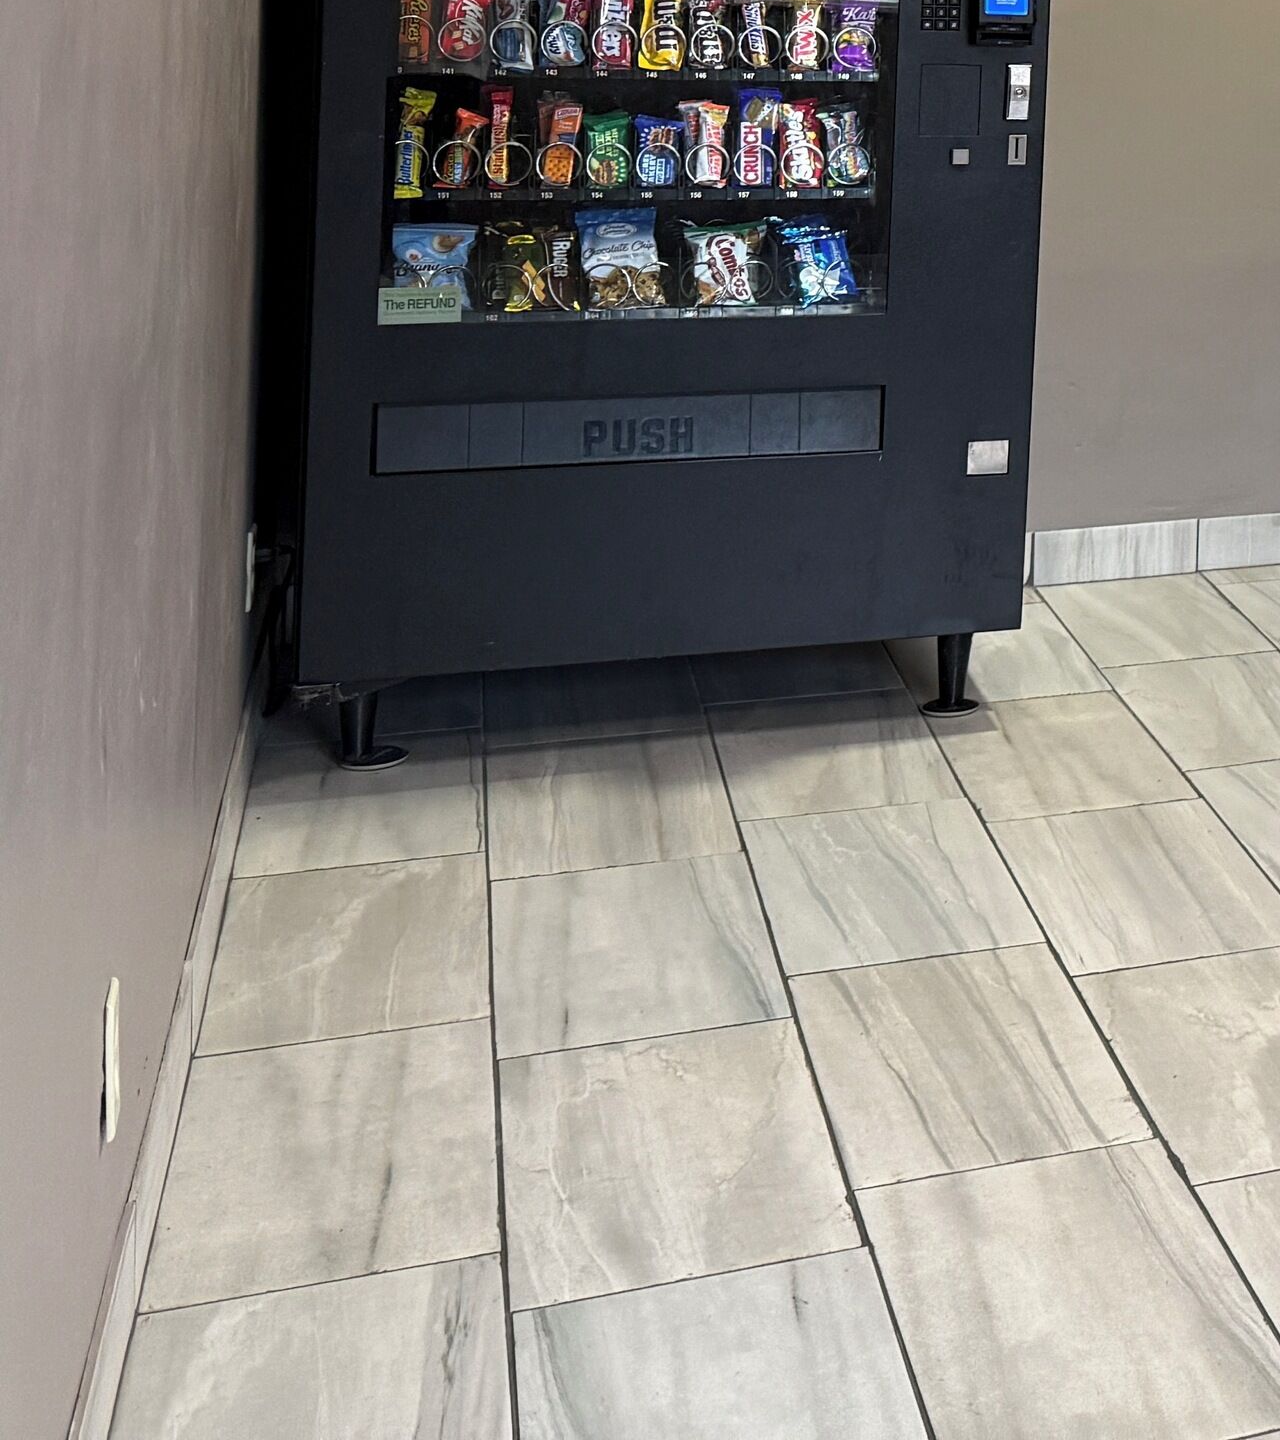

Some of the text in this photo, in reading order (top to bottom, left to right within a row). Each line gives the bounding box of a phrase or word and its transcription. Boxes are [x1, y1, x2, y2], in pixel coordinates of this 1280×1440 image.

[441, 67, 455, 75] 141
[494, 68, 507, 76] 142
[545, 68, 558, 76] 143
[595, 70, 608, 78] 144
[742, 72, 756, 80] 147
[397, 129, 415, 184] Butterfiner
[743, 121, 760, 184] CRUNCH
[583, 240, 655, 260] Chocolate Chip
[551, 238, 569, 278] RUGER
[384, 296, 457, 311] The REFUND
[582, 416, 695, 458] PUSH
